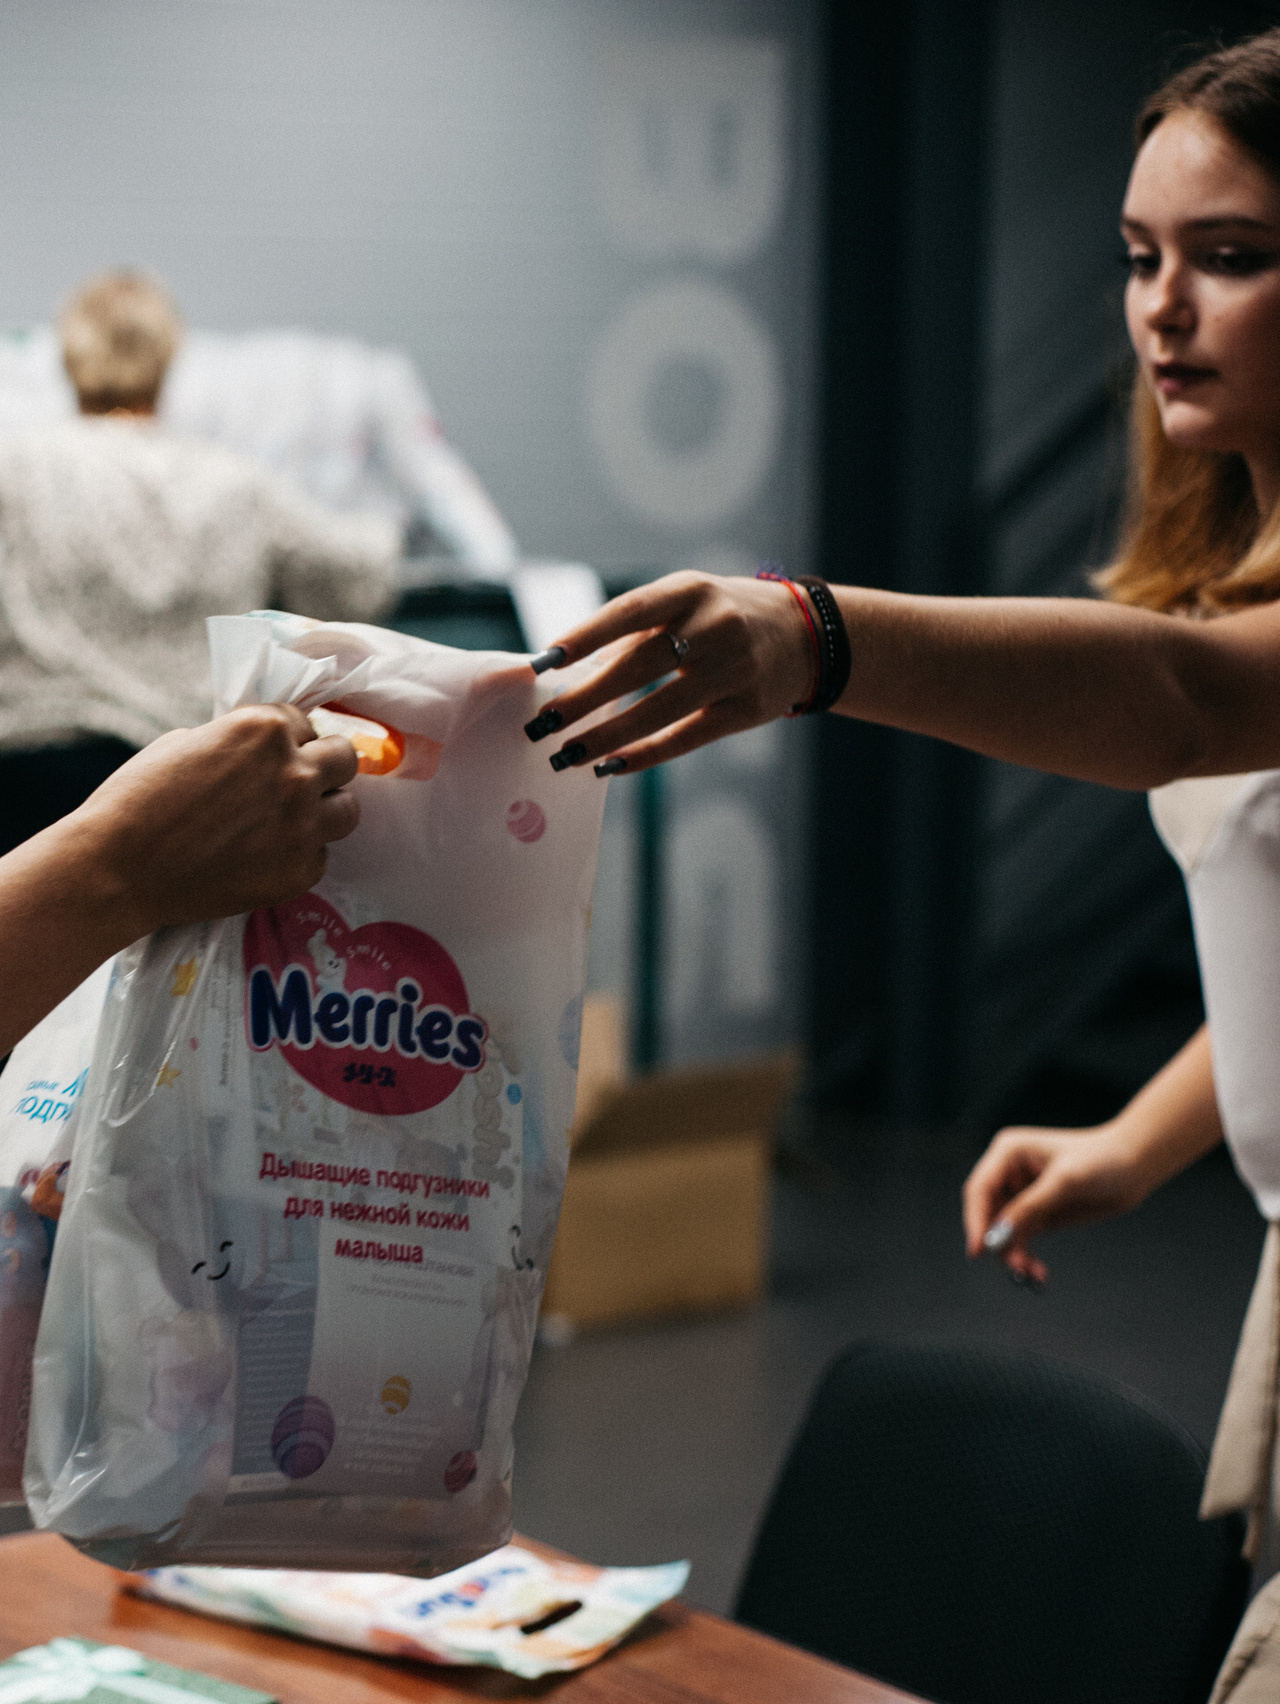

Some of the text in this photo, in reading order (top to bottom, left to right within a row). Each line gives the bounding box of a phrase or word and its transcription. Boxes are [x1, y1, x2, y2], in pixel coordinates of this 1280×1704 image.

[247, 965, 487, 1070] Merries
[259, 1152, 489, 1197] Дышащие подгузники
[284, 1196, 469, 1230] для нежной кожи
[335, 1239, 423, 1263] малыша
